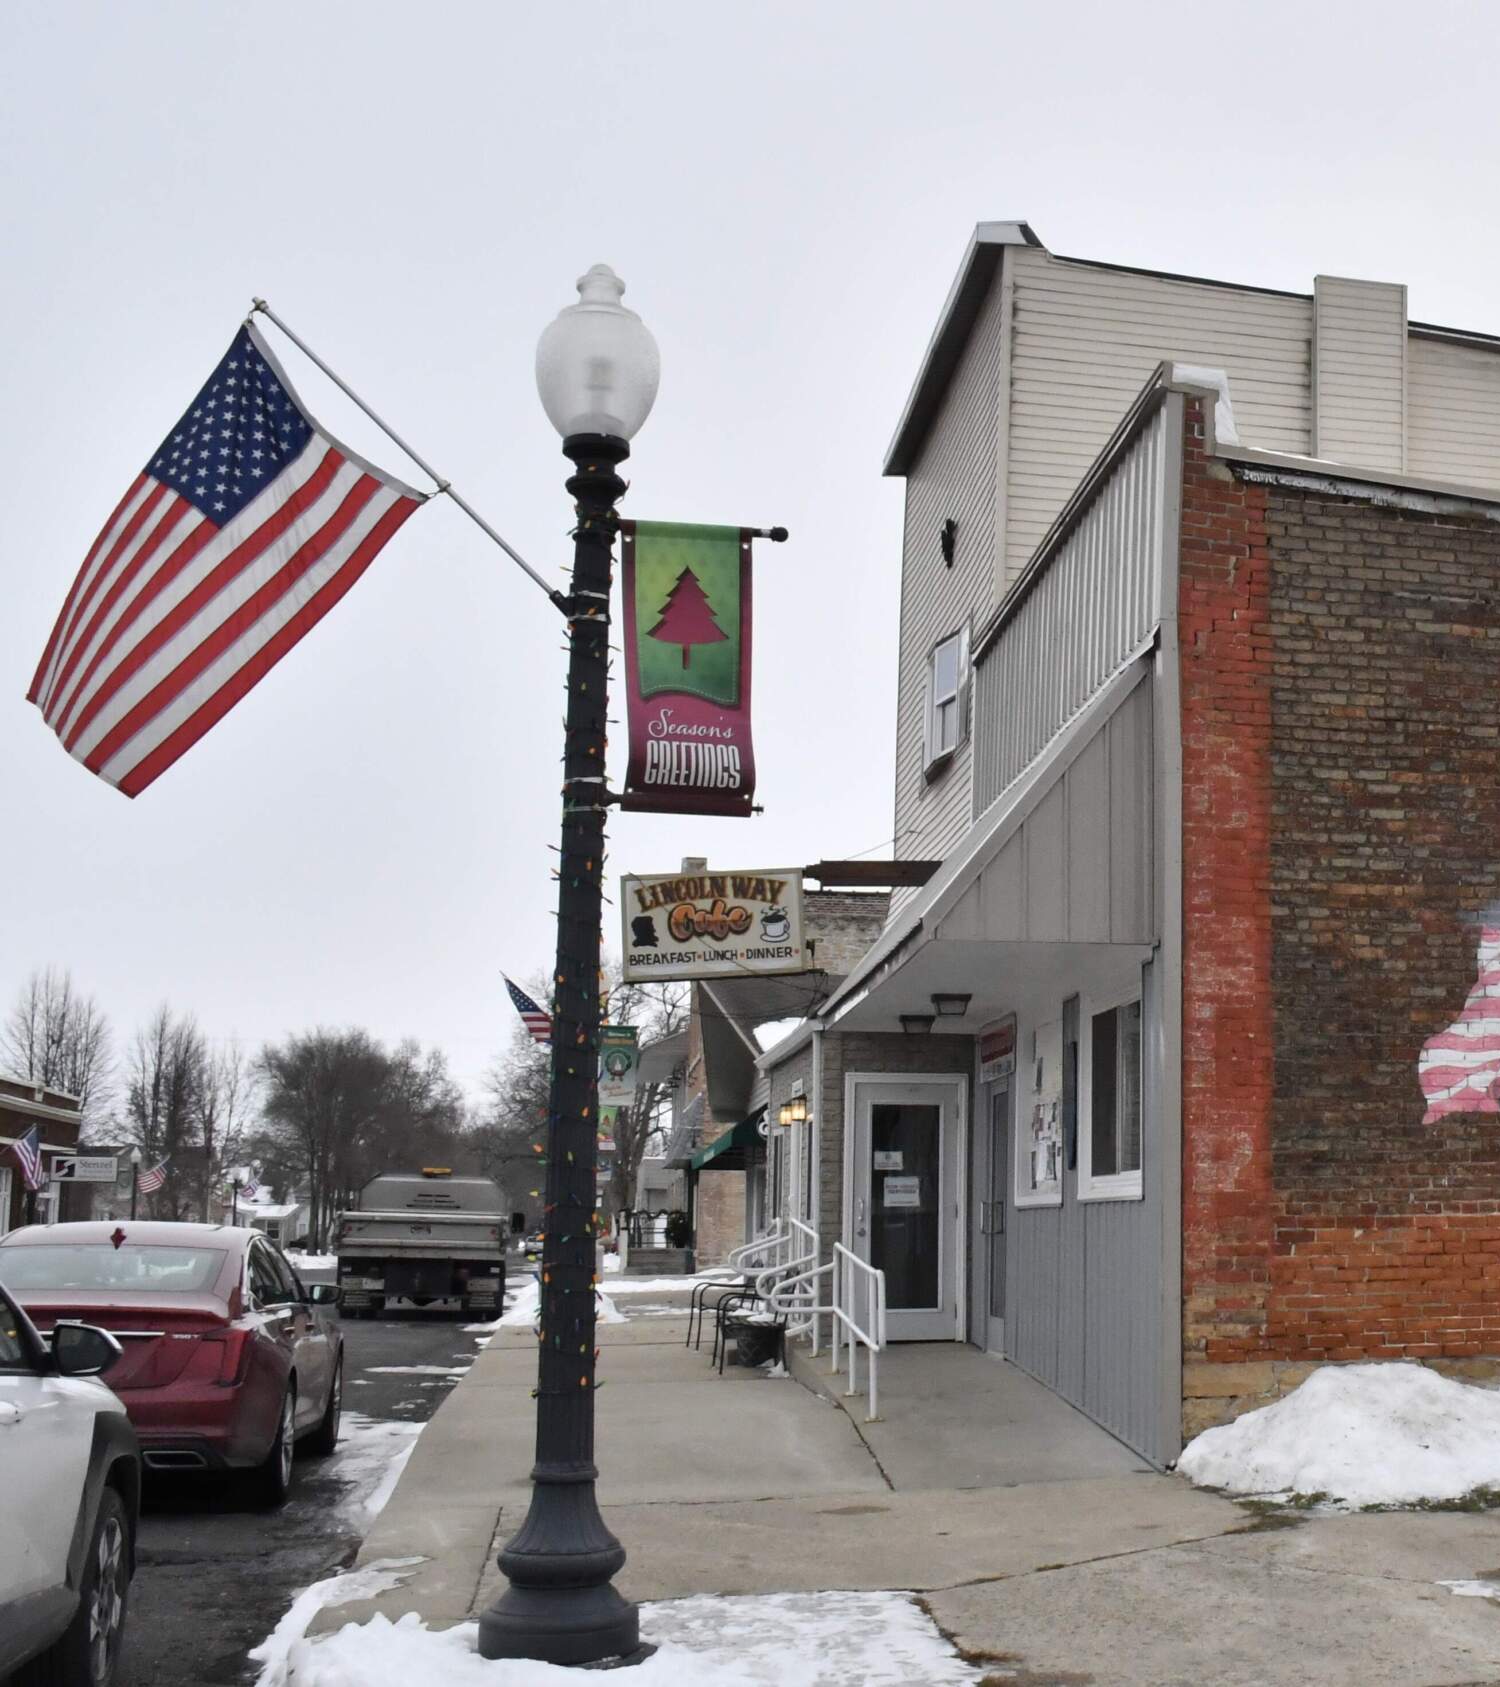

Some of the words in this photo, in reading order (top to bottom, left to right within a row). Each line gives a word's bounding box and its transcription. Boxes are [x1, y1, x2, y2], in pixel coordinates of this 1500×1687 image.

[648, 708, 734, 738] Season's
[644, 740, 741, 789] GREETINGS
[634, 876, 730, 913] LINCOLN
[730, 876, 788, 905] WAY
[667, 899, 753, 943] Cafe
[629, 951, 697, 966] BREAKFAST
[703, 949, 738, 962] LUNCH
[746, 946, 793, 960] DINNER
